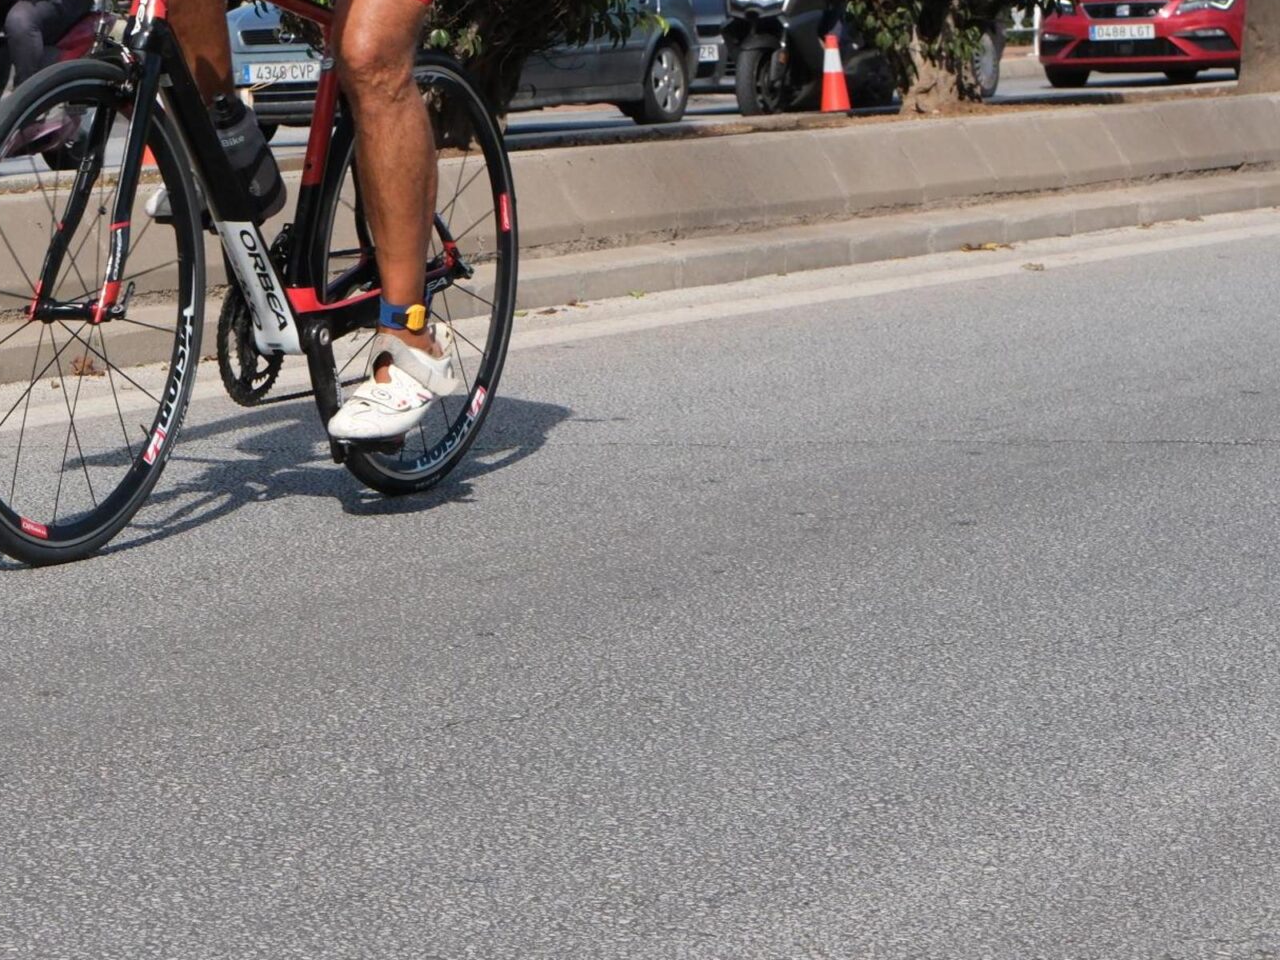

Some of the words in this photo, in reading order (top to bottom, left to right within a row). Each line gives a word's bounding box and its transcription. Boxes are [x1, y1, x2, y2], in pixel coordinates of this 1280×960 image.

[255, 65, 288, 81] 4348
[290, 63, 315, 80] CVP
[220, 135, 245, 148] Bike
[239, 228, 289, 332] ORBEA
